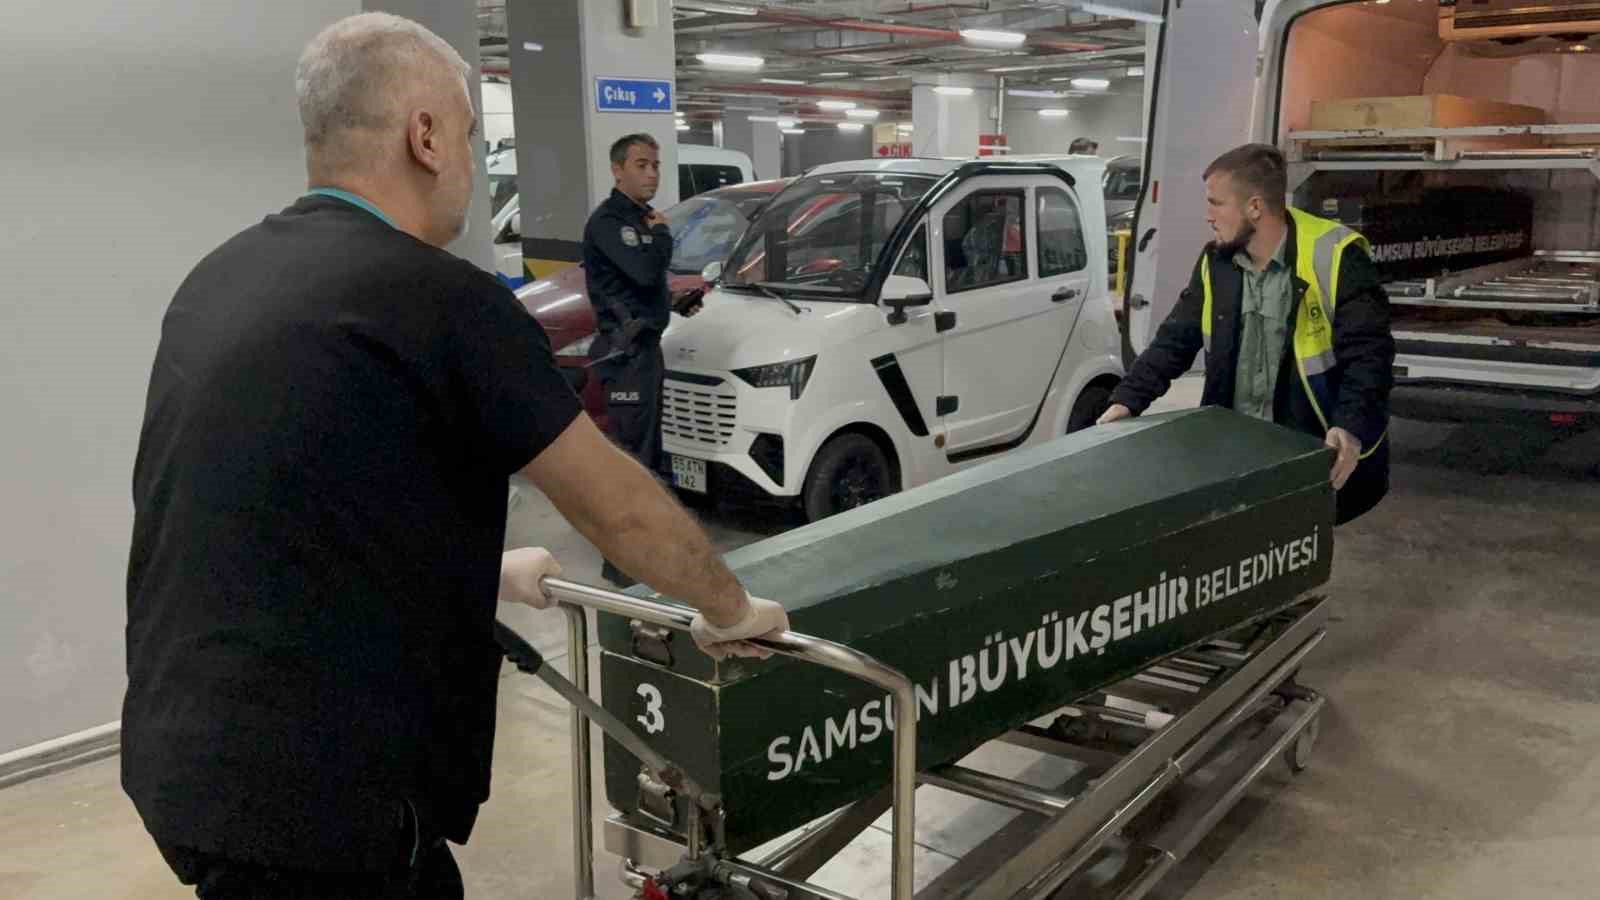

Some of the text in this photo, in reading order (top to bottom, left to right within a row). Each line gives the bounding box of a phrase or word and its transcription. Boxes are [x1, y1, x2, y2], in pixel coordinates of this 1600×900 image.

[604, 86, 636, 106] Çıkış
[1368, 241, 1412, 263] SAMSUN
[672, 455, 685, 471] 55
[681, 473, 697, 488] 142
[949, 570, 1189, 708] BÜYÜKŞEHİR
[1195, 525, 1319, 608] BELEDİYESİ
[636, 683, 664, 734] 3
